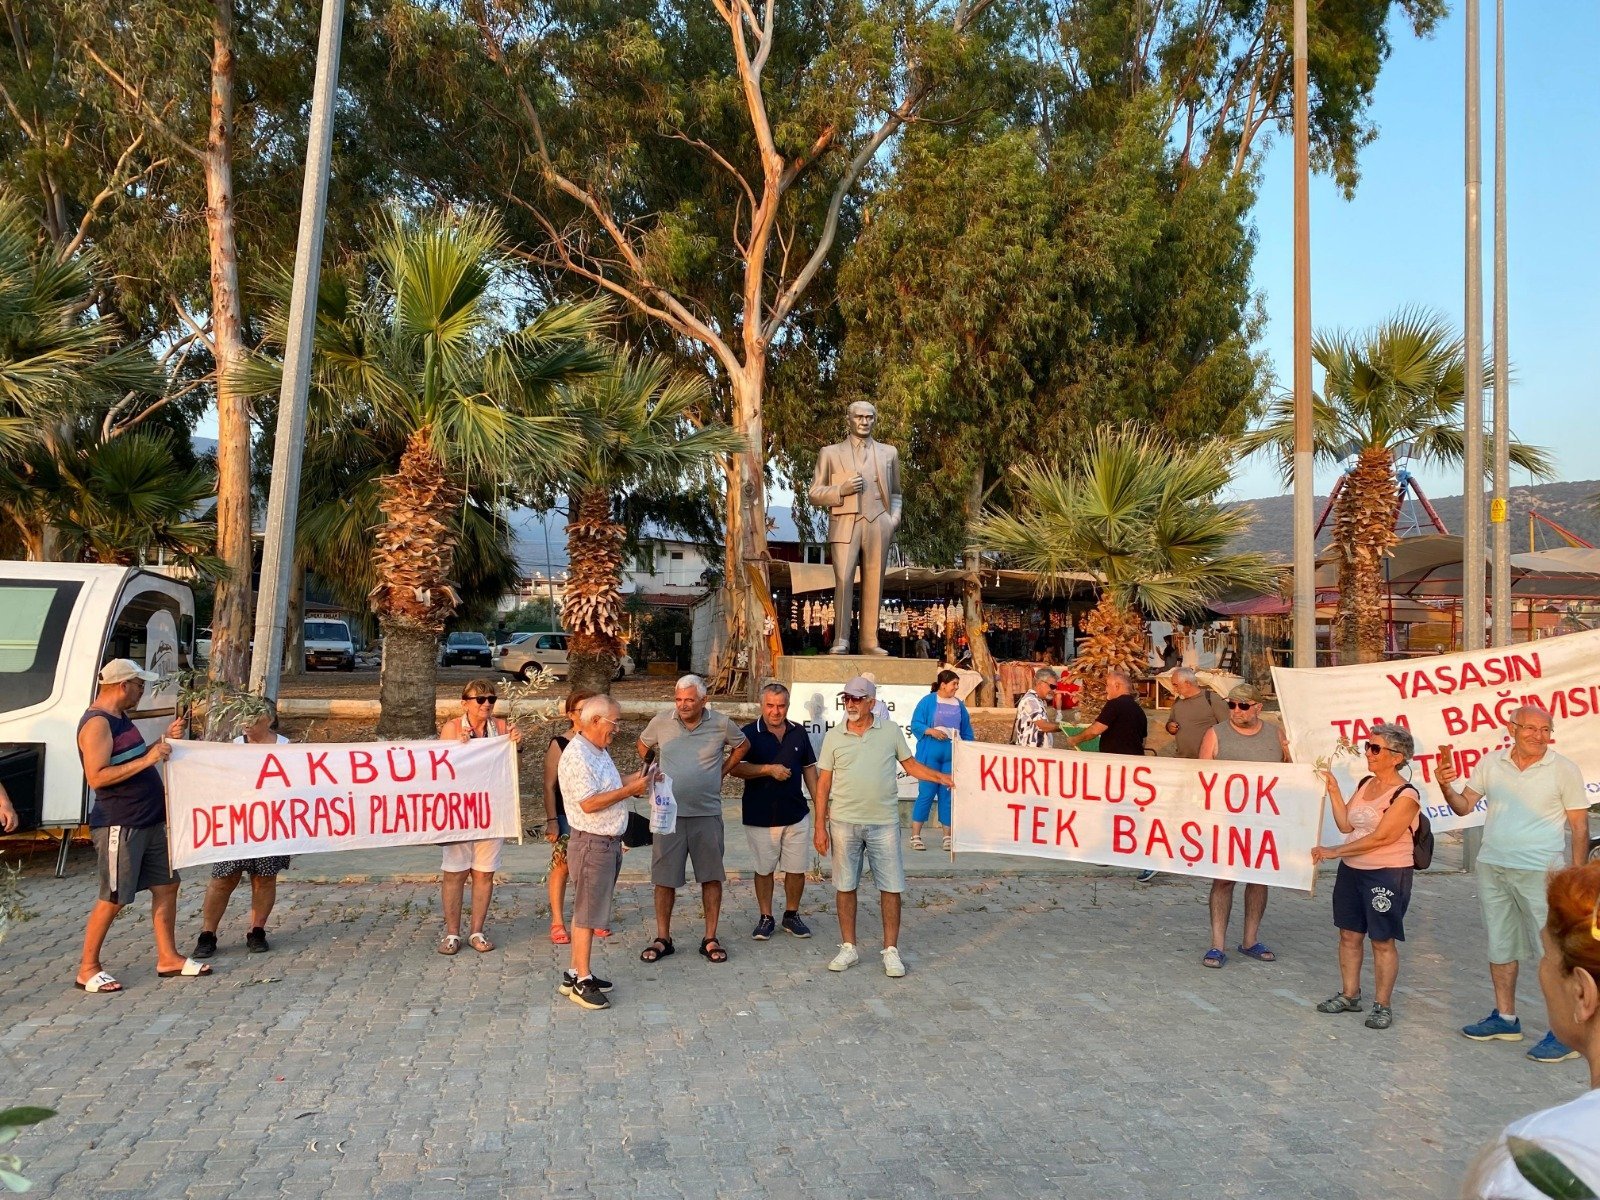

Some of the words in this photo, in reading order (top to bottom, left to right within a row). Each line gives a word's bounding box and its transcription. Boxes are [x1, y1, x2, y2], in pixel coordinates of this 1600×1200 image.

[1386, 652, 1542, 700] YAŞASIN
[255, 747, 457, 790] AKBÜK
[980, 754, 1157, 812] KURTULUŞ
[1198, 771, 1281, 816] YOK
[192, 791, 356, 849] DEMOKRASİ
[370, 792, 491, 835] PLATFORMU
[1007, 803, 1080, 849] TEK
[1113, 814, 1280, 871] BAŞINA
